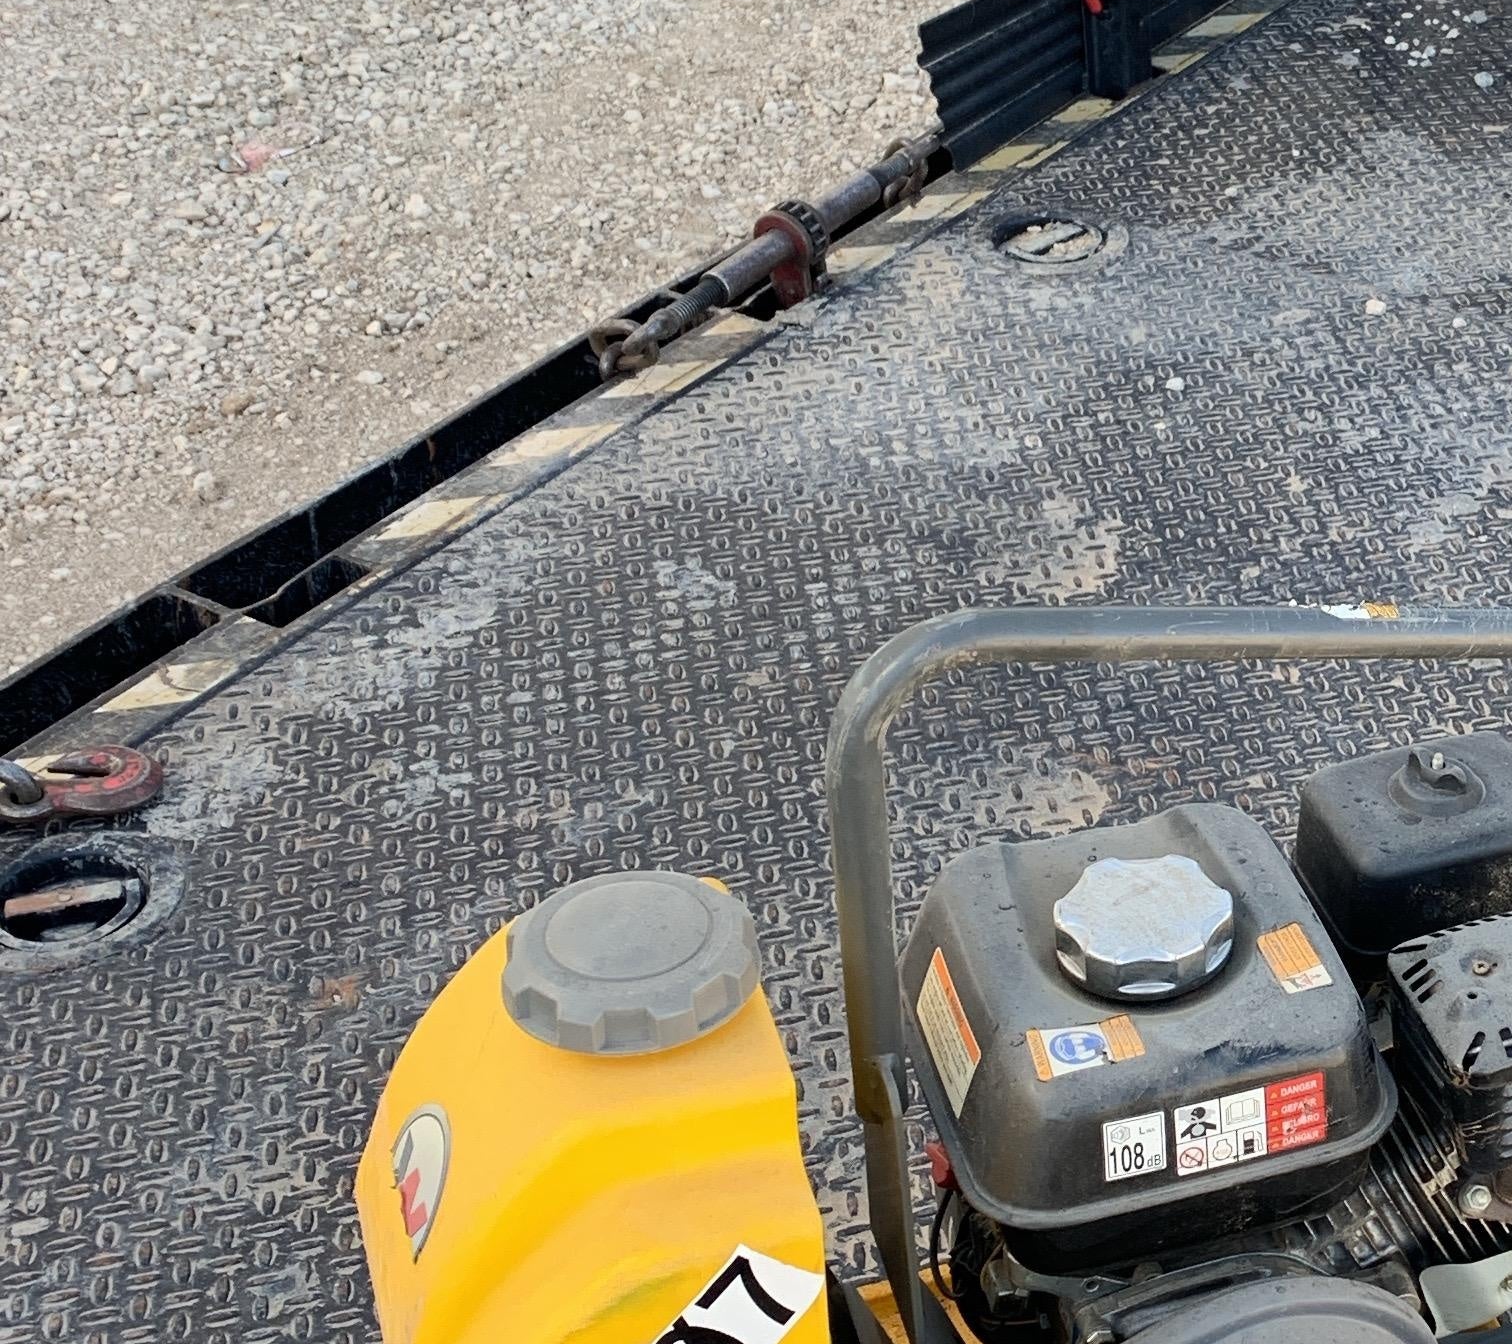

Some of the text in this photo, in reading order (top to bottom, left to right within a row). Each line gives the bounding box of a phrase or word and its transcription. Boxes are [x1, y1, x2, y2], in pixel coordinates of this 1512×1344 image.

[1280, 1079, 1317, 1097] DANGER
[1109, 1142, 1162, 1174] 108 dB
